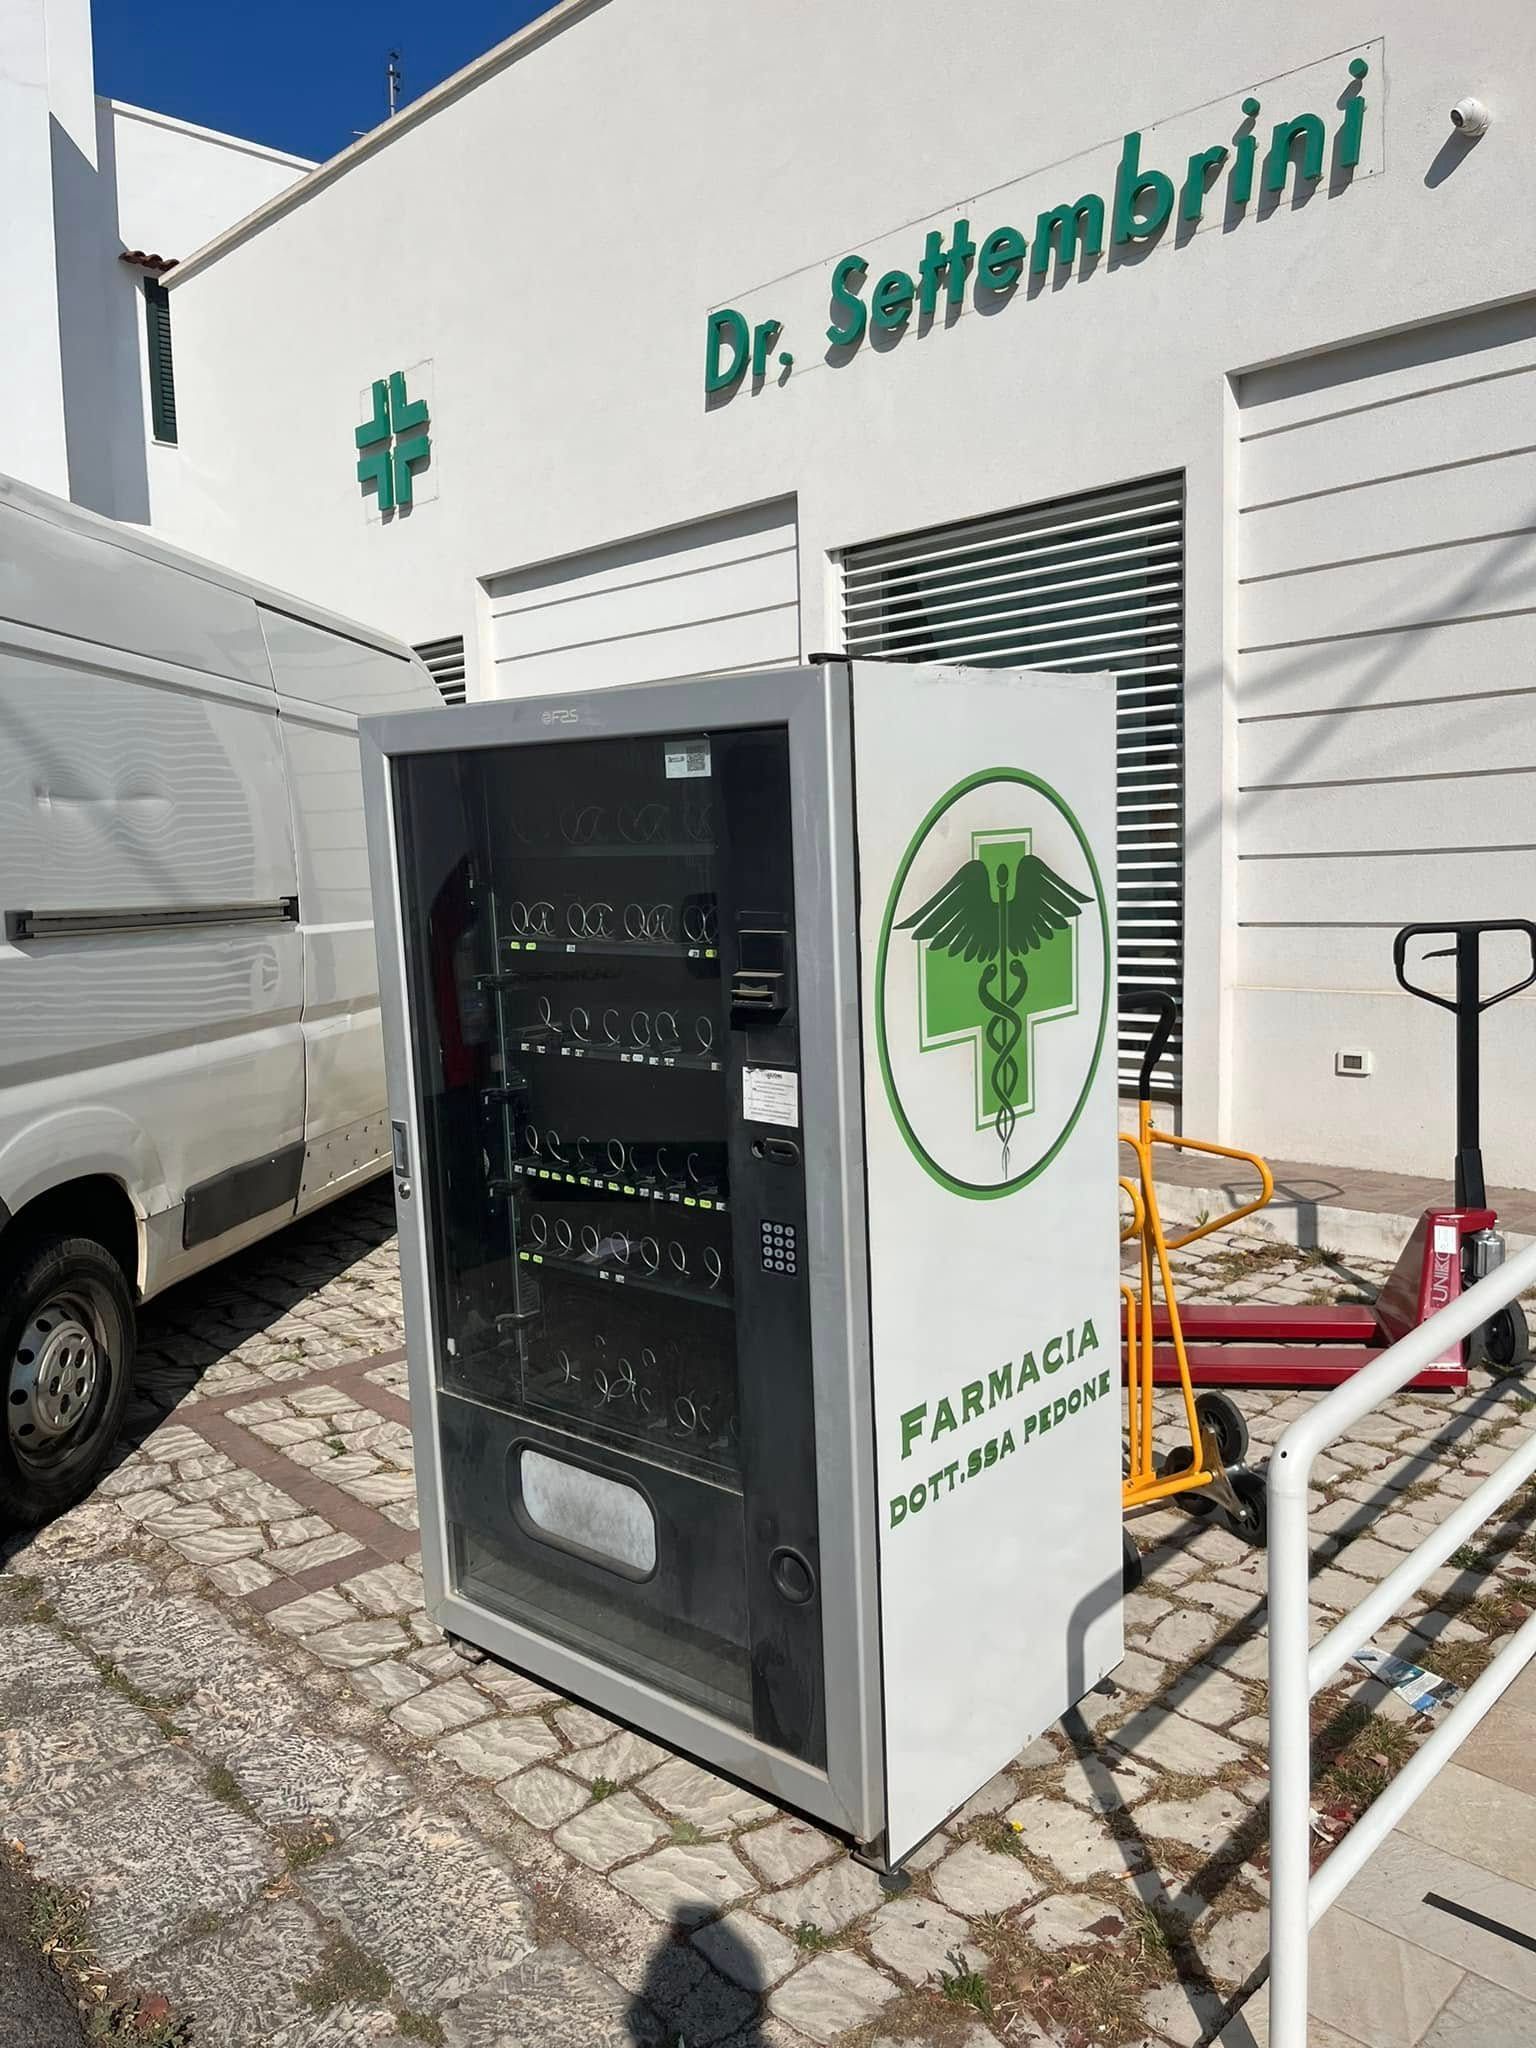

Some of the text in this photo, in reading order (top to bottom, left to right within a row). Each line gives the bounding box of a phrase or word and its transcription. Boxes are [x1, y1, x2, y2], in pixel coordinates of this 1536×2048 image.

[826, 58, 1368, 346] Settembrini
[900, 1319, 1099, 1460] FARMACIA
[1024, 1369, 1110, 1444] PEDONE
